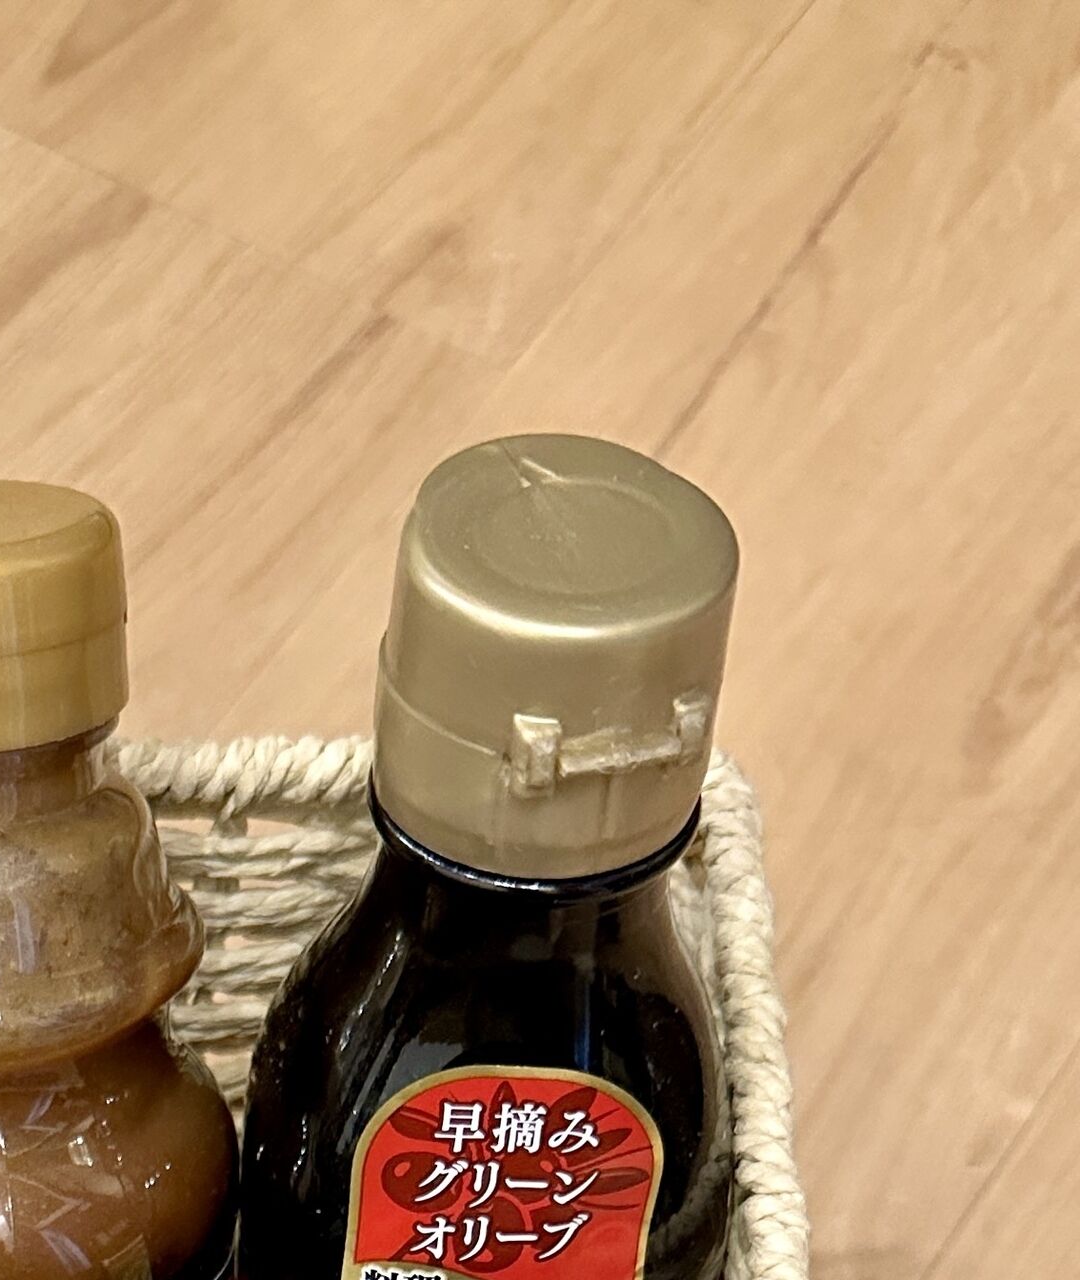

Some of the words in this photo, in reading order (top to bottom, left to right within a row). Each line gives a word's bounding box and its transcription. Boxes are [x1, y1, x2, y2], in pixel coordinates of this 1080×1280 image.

[434, 1101, 601, 1154] 早摘み
[414, 1160, 601, 1209] グリーン
[409, 1214, 591, 1262] オリーブ
